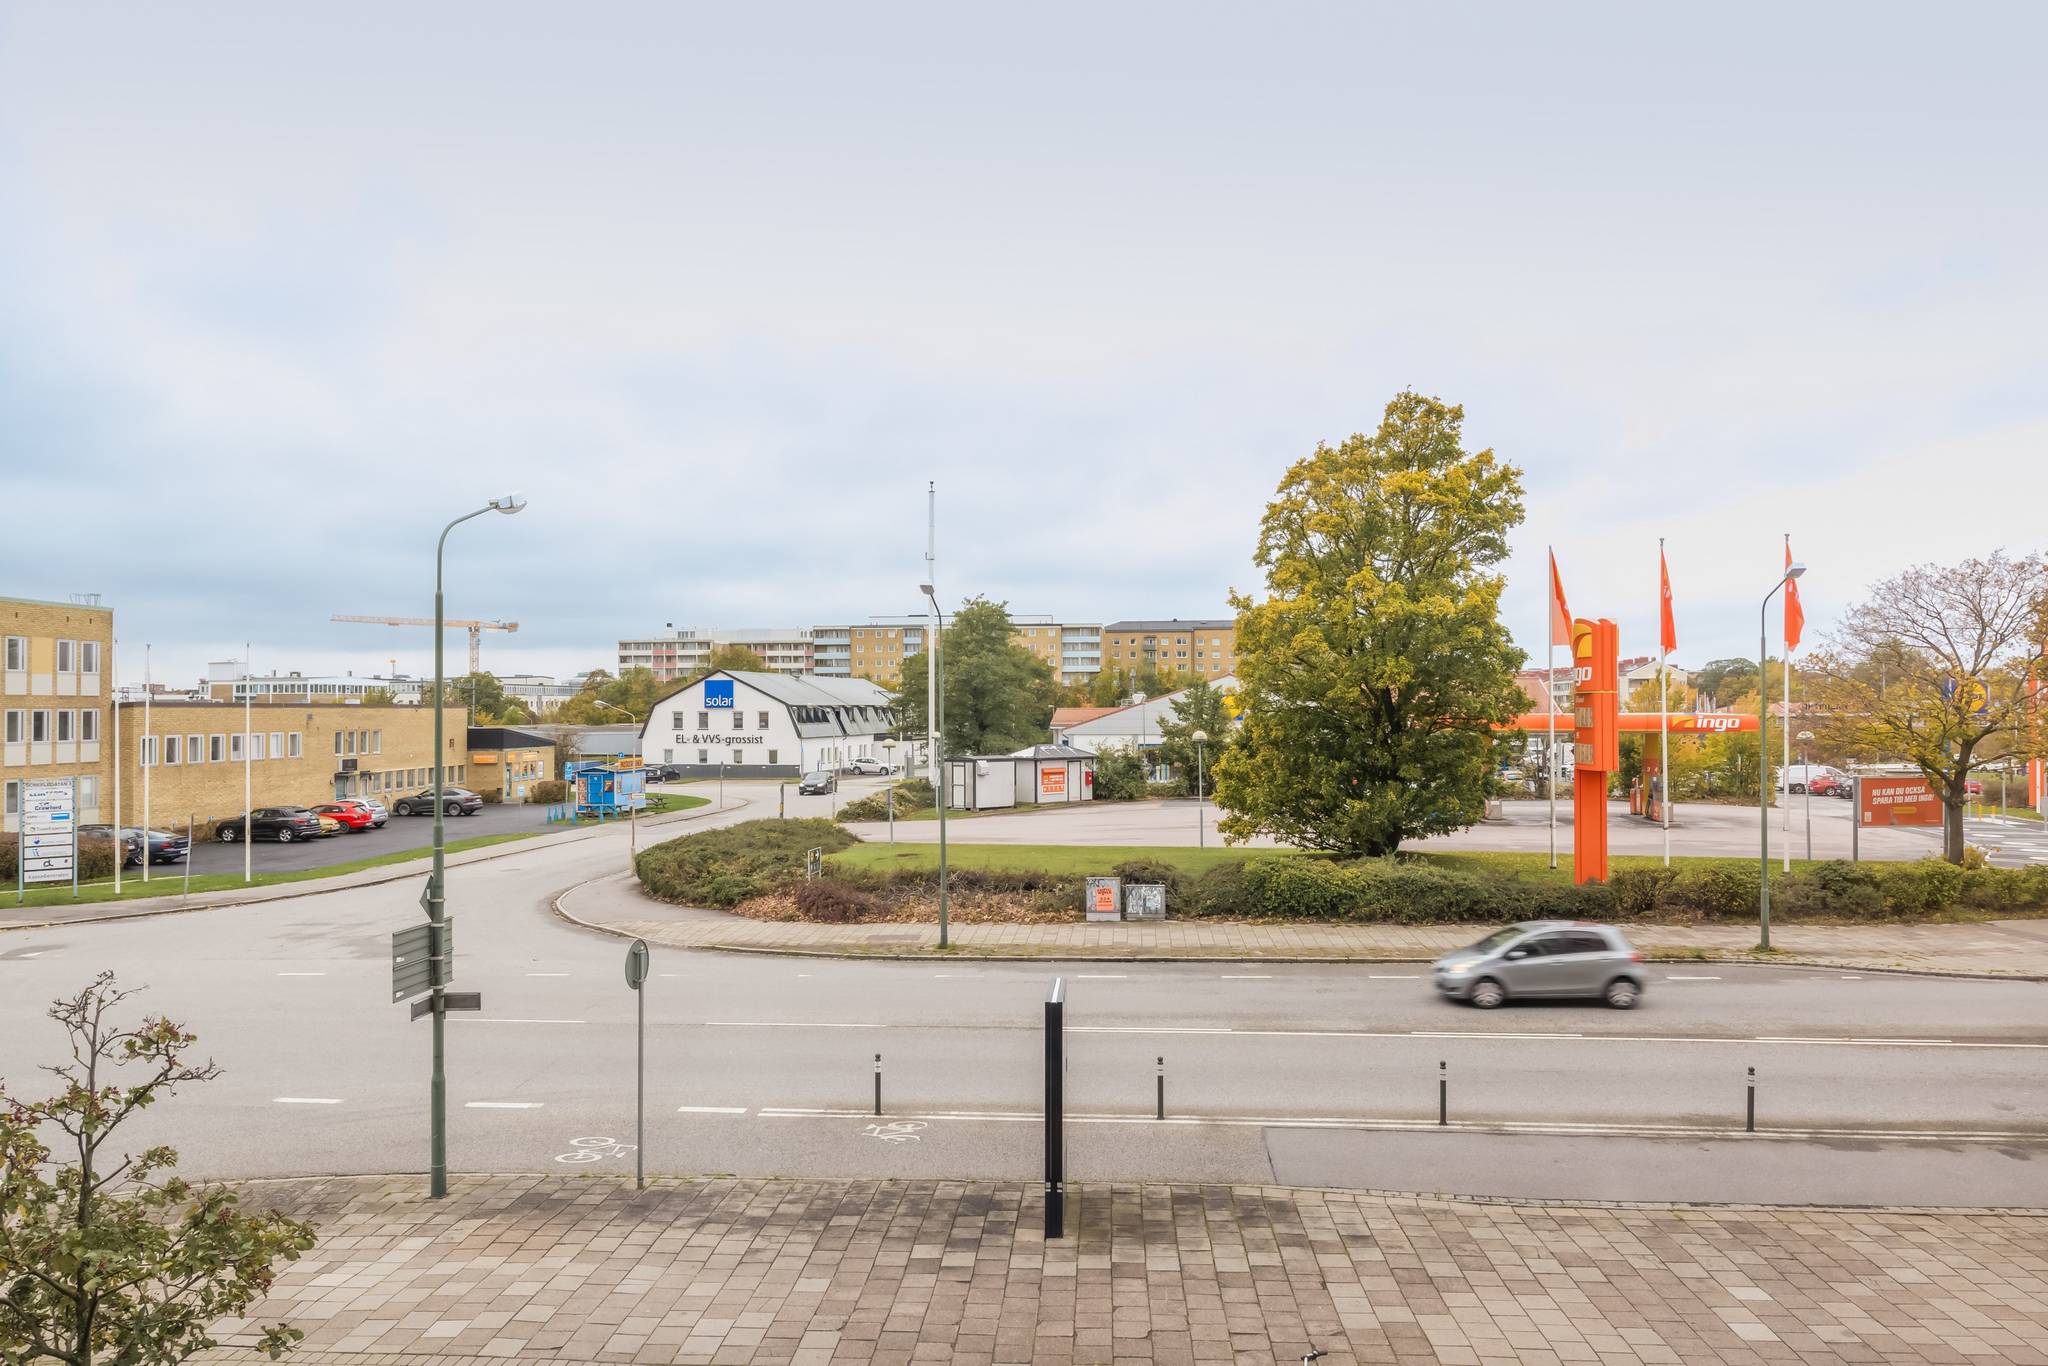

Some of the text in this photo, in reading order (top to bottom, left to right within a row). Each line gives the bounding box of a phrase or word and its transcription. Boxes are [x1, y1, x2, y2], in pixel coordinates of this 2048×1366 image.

[705, 694, 733, 707] solar
[1696, 715, 1740, 732] ingo
[675, 734, 690, 744] EL-
[692, 734, 700, 744] &
[1882, 788, 1895, 796] KAN
[1896, 787, 1905, 795] DU
[1872, 797, 1893, 805] SPARA
[1904, 795, 1918, 803] MED
